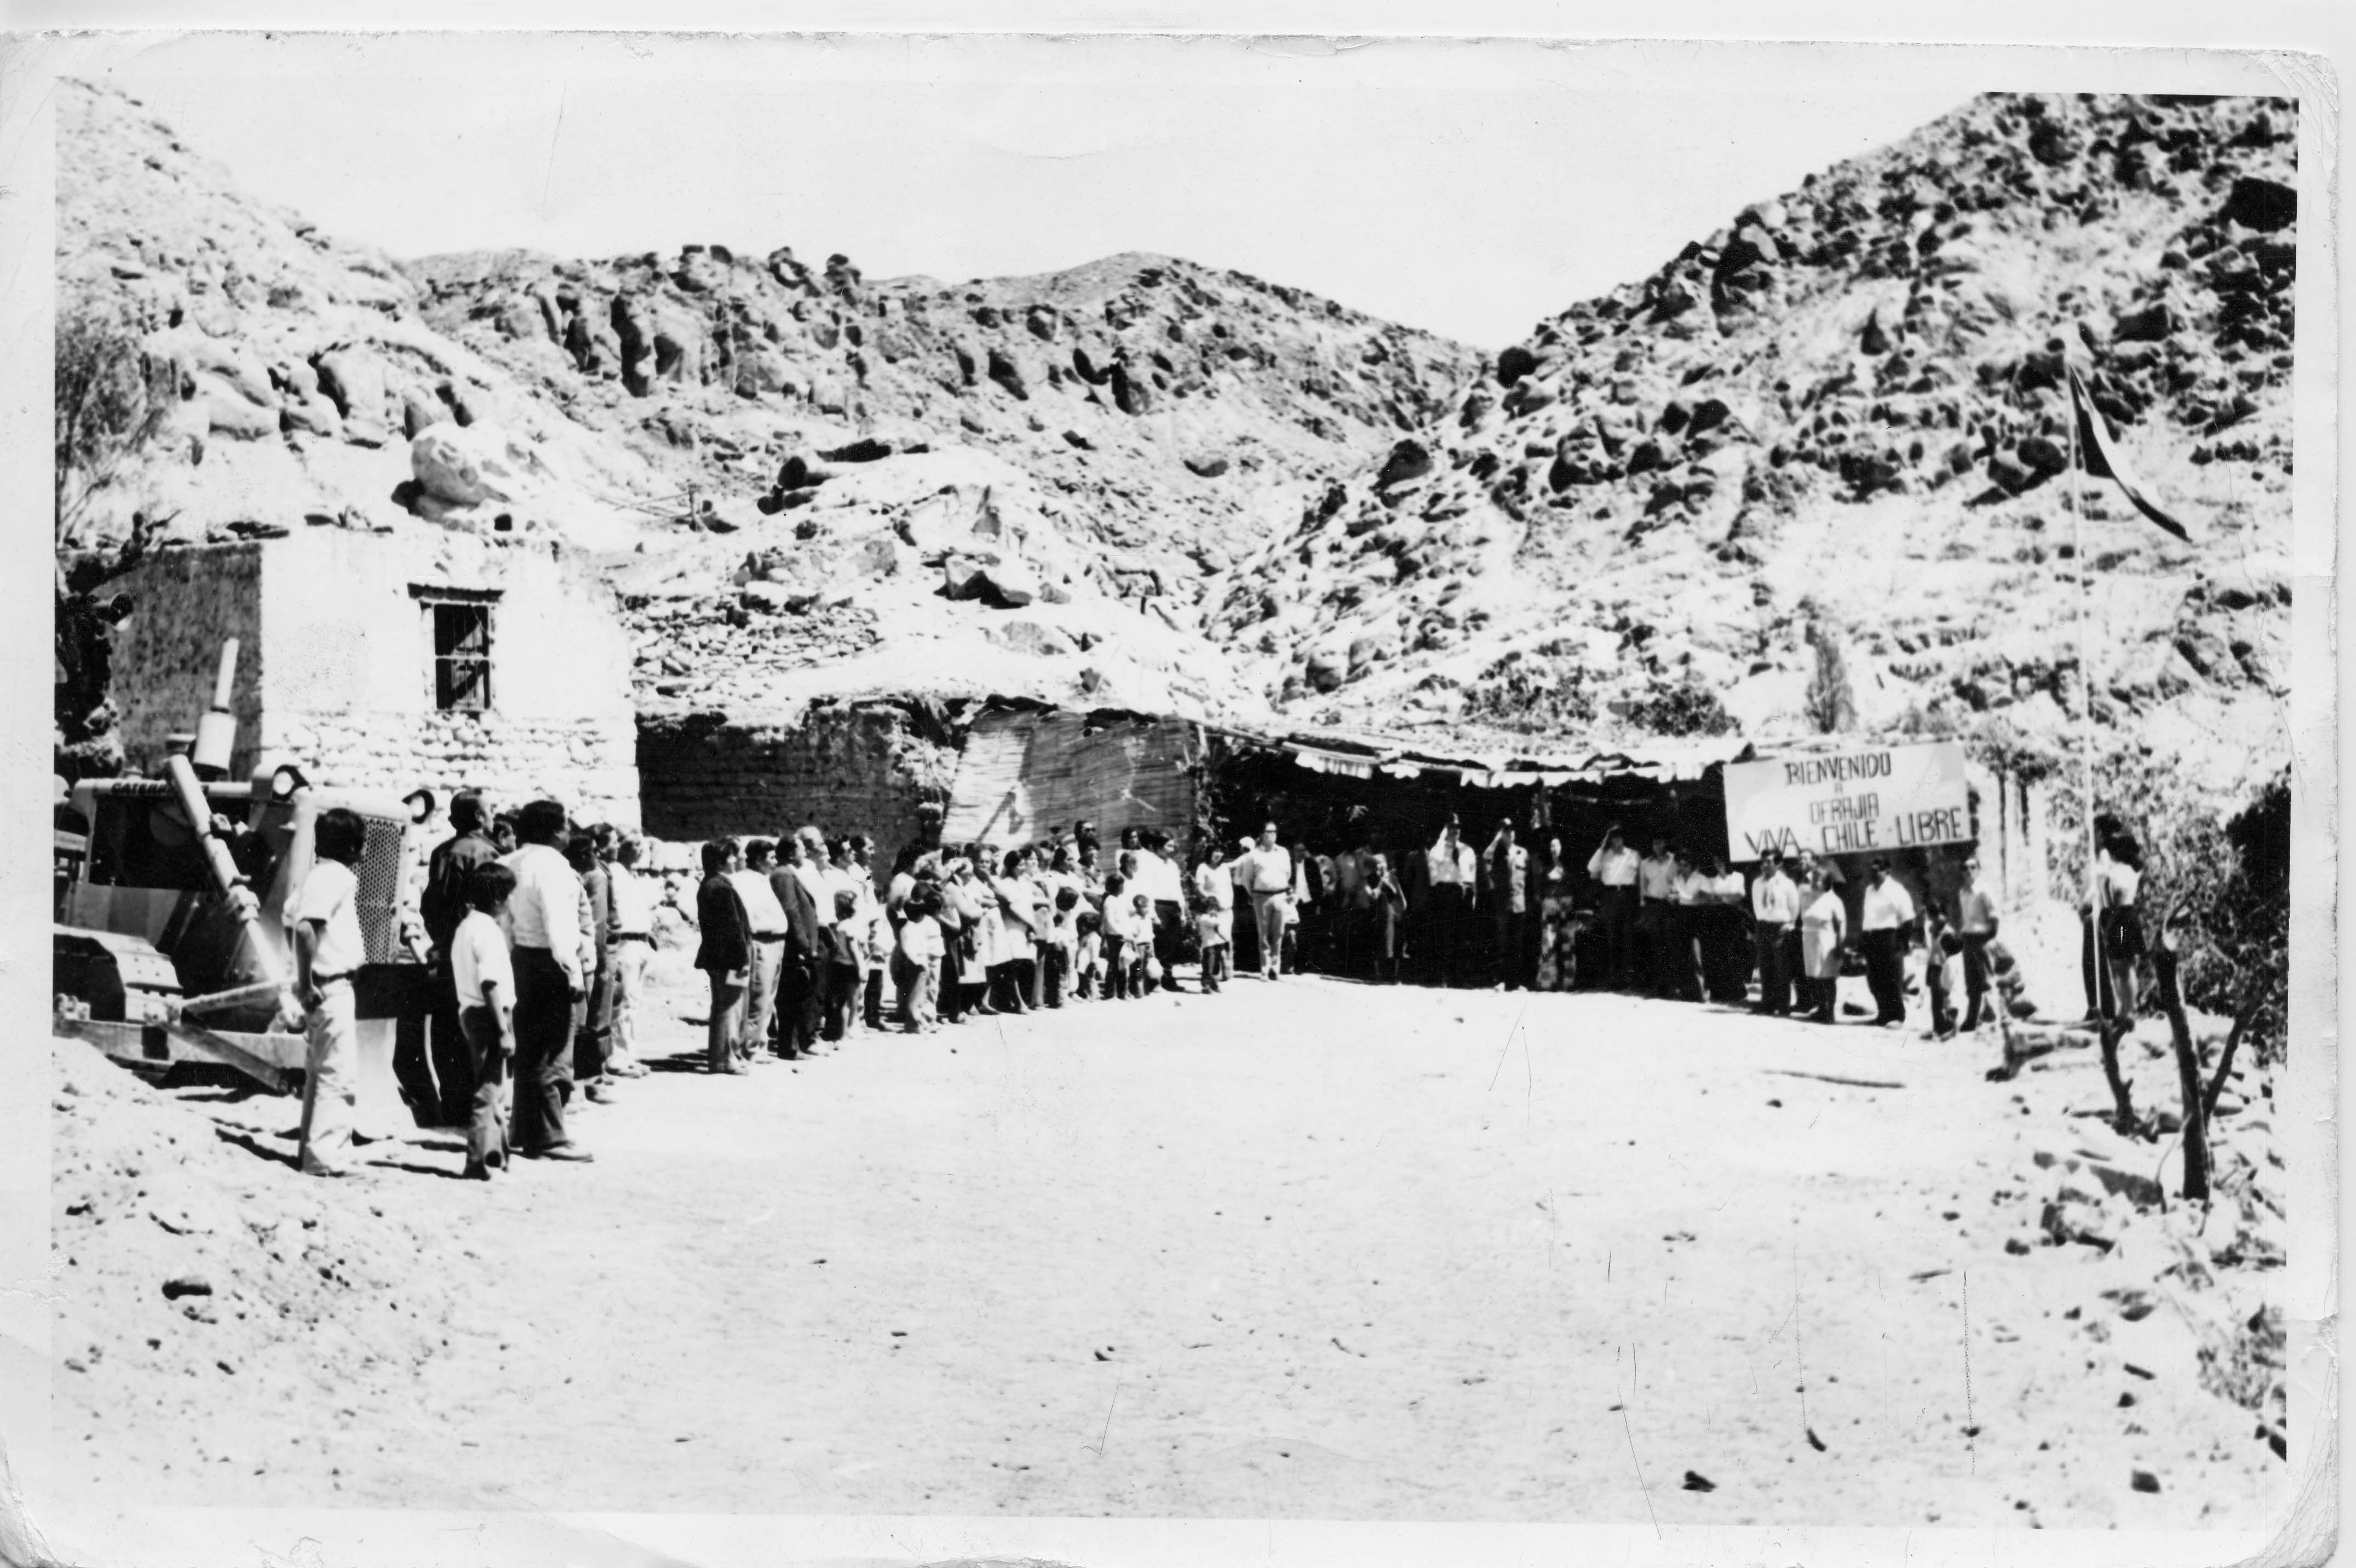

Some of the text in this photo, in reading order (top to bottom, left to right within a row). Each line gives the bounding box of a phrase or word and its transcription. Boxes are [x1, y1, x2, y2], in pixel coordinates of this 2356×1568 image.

[1745, 807, 1963, 855] VIVA CHILE LIBRE
